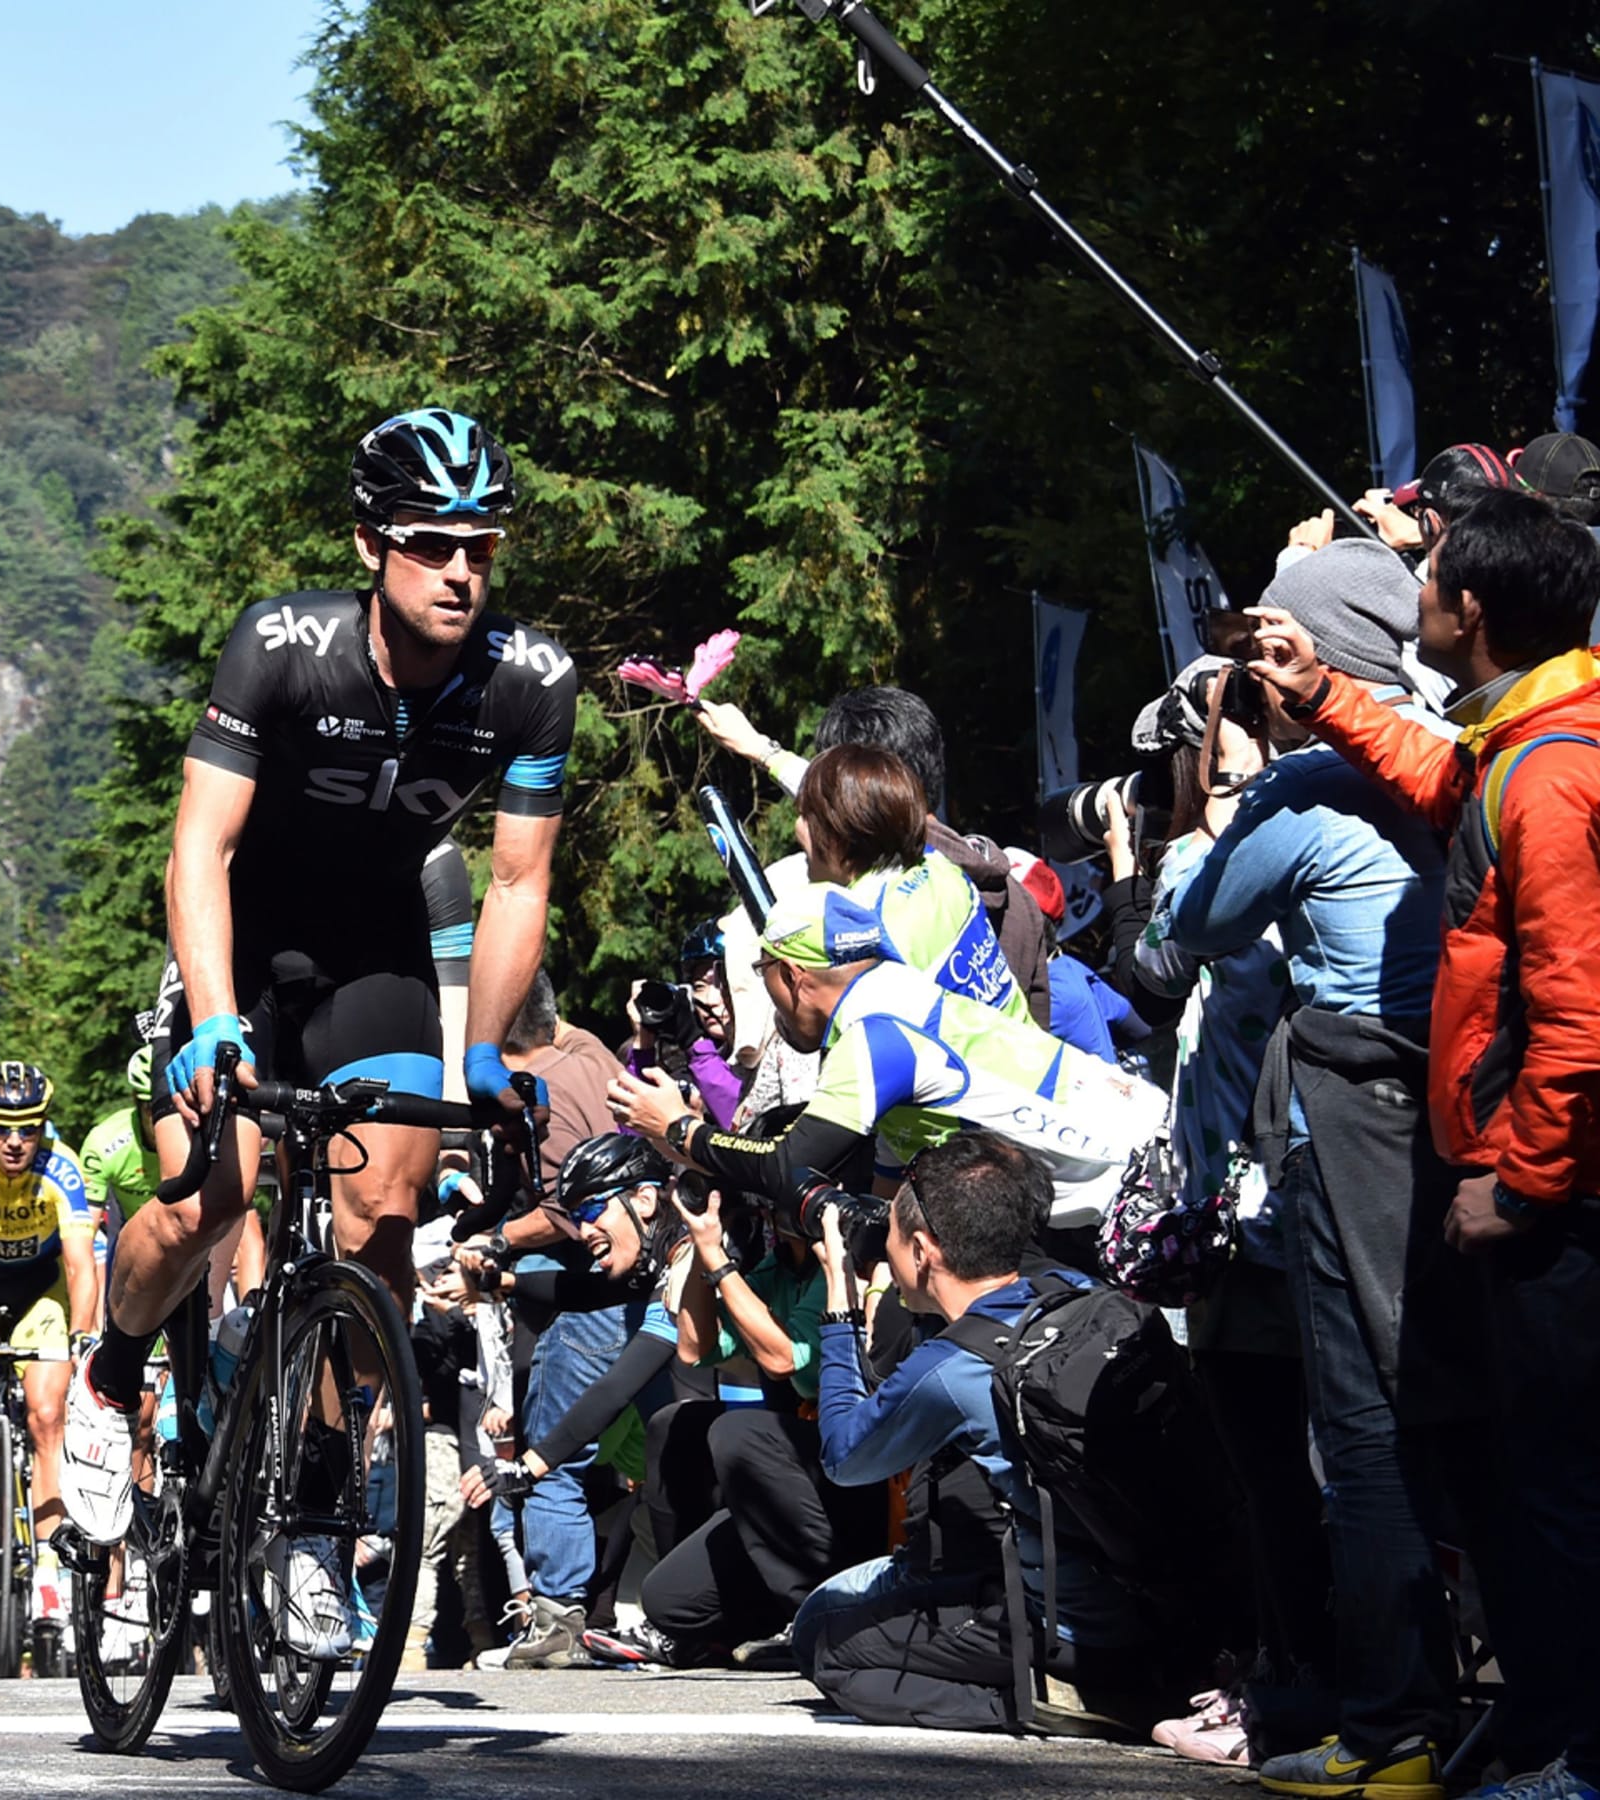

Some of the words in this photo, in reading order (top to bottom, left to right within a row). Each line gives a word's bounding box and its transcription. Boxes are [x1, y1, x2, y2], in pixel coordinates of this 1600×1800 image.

[256, 605, 340, 657] sky
[487, 630, 574, 687] sky
[304, 759, 485, 825] sky
[35, 1152, 81, 1191] SAXO
